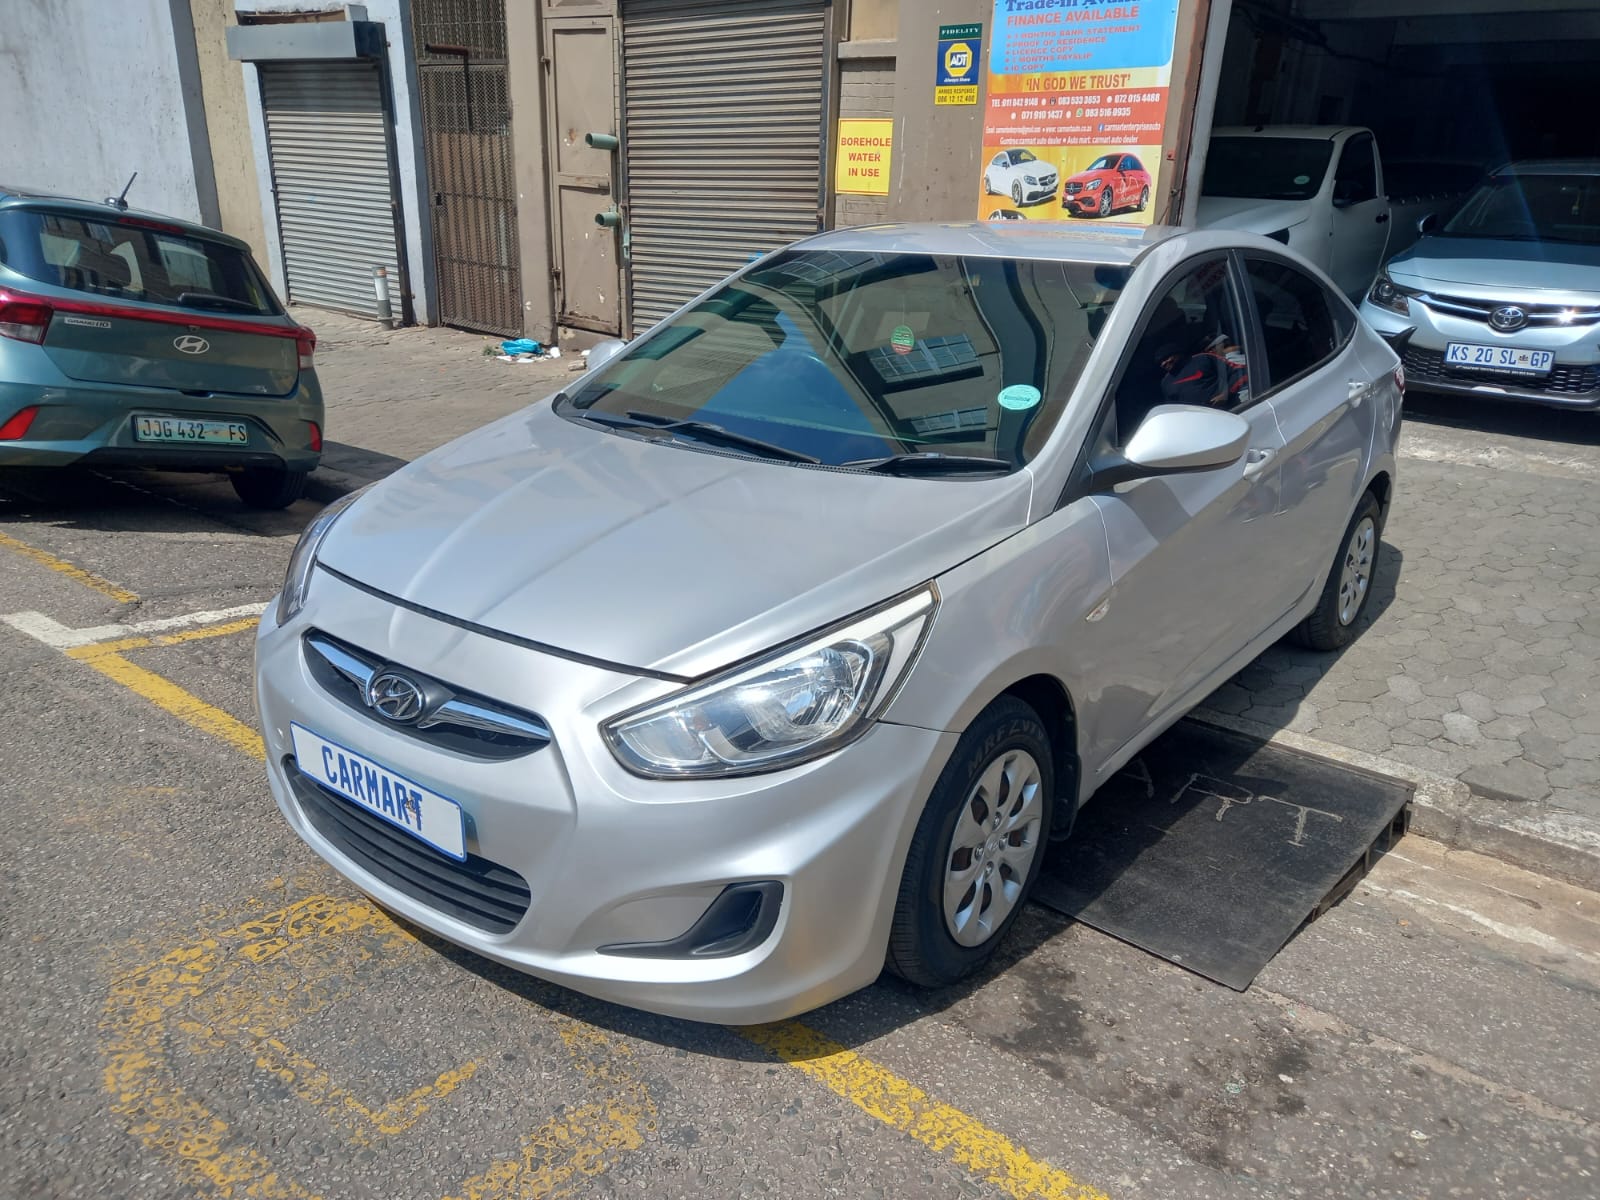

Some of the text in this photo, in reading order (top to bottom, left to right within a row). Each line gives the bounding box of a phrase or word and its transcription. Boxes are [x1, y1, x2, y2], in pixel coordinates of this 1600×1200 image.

[1005, 0, 1078, 11] Trade-in
[1008, 6, 1139, 26] FINANCE AVAILABLE
[942, 27, 979, 35] FIDELITY
[1021, 31, 1056, 39] MONTHS
[1059, 29, 1083, 37] BANK
[1087, 24, 1140, 35] STATEMENT
[1057, 36, 1106, 45] RESIDENCE
[1012, 45, 1073, 55] LICENCE COPY
[950, 53, 968, 67] ADT
[1057, 52, 1092, 60] PAYSLIP
[1011, 63, 1044, 72] ID COPY
[1044, 76, 1070, 90] GOD
[1071, 75, 1086, 89] WE
[1114, 94, 1127, 103] 072
[1021, 110, 1033, 120] 071
[1034, 110, 1046, 119] 910
[841, 137, 892, 147] BOREHOLE
[848, 152, 881, 162] WATER
[848, 167, 880, 177] IN USE
[1451, 345, 1549, 367] KS 20 SL GP
[143, 419, 246, 442] JJG 432 FS
[321, 745, 423, 832] CARMART
